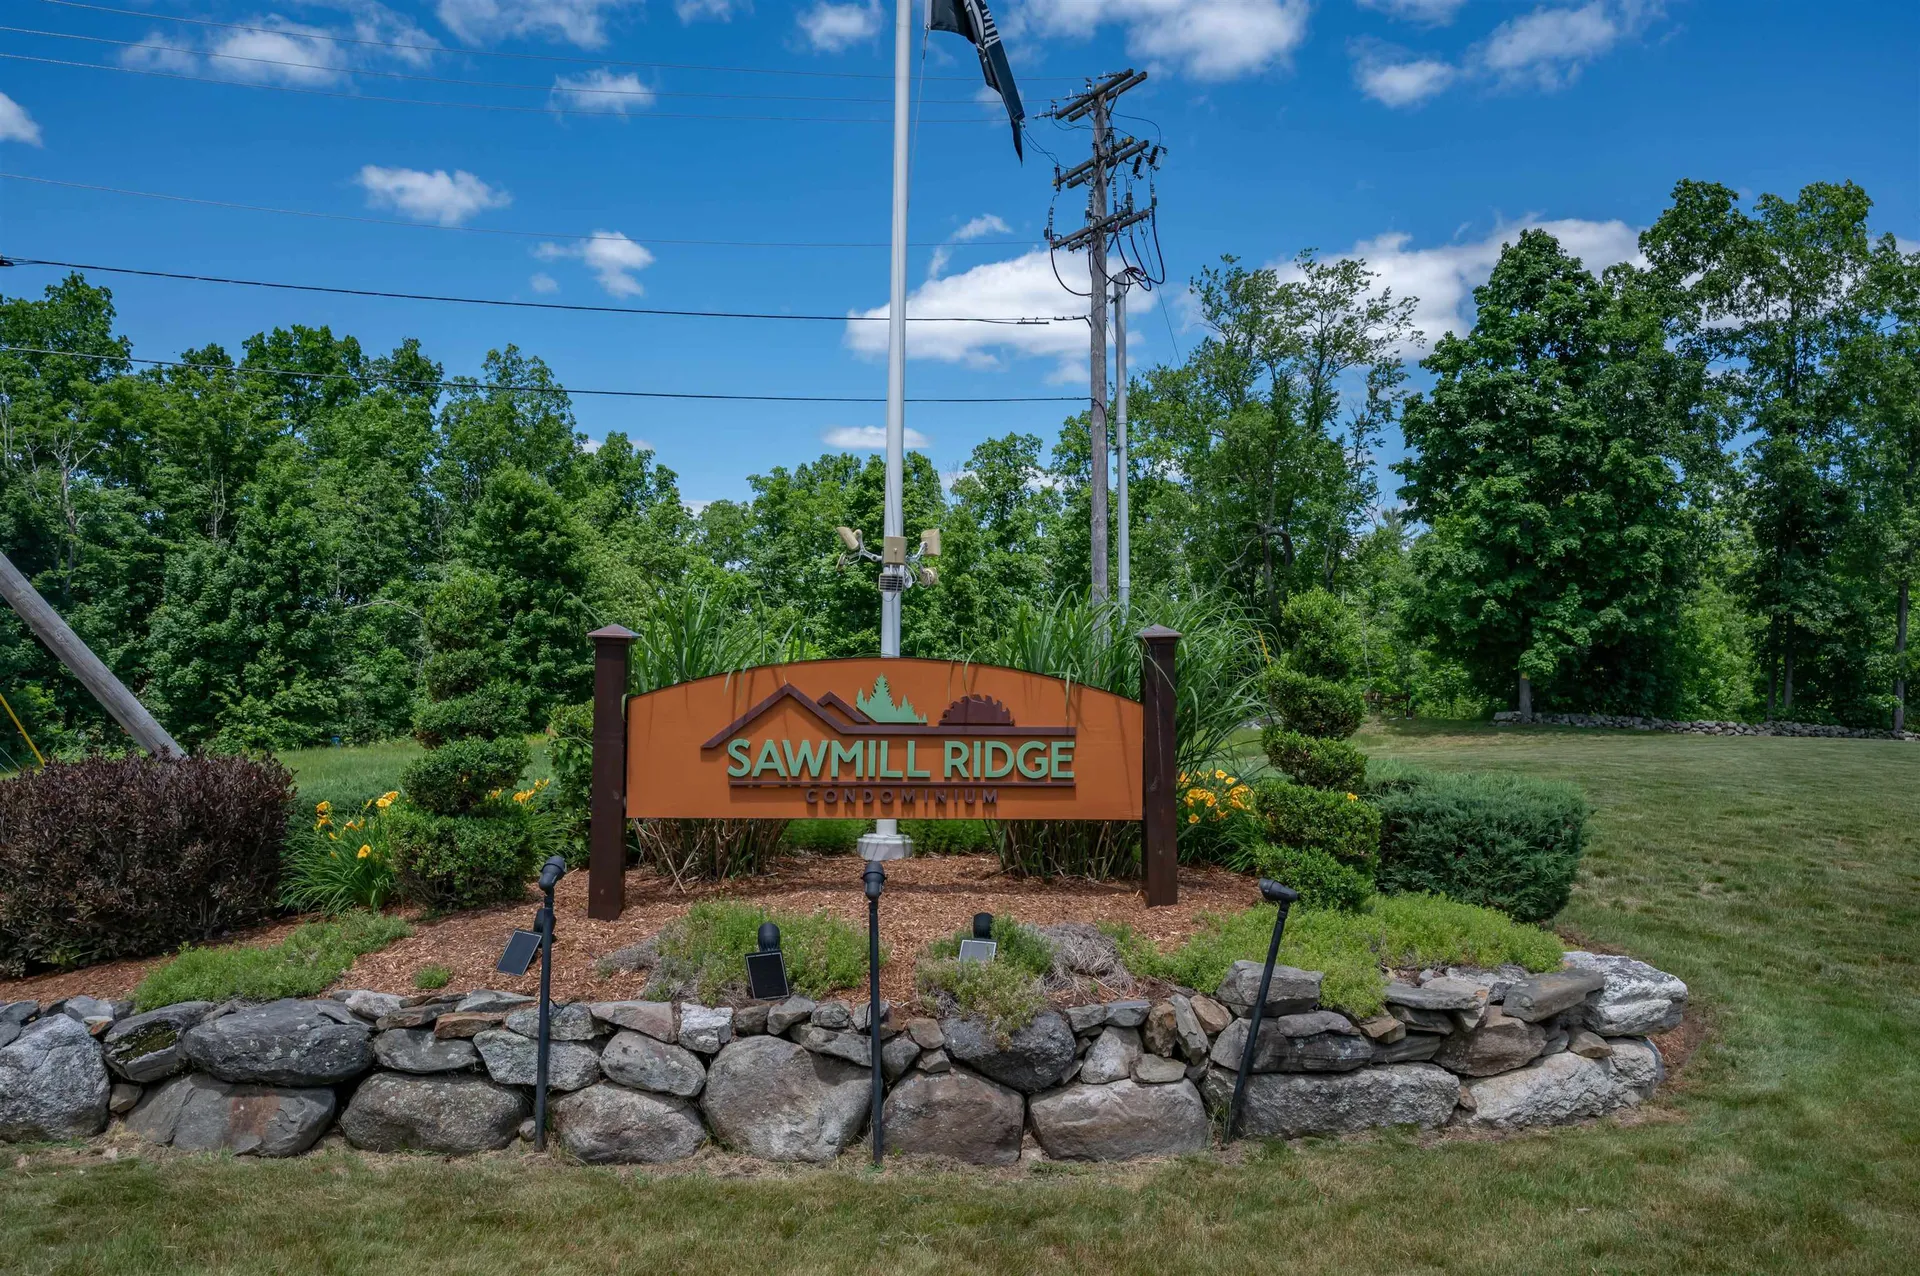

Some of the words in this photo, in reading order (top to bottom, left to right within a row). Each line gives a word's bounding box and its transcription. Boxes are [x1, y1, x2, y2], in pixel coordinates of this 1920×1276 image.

[727, 738, 931, 778] SAWMILL
[944, 740, 1075, 779] RIDGE
[805, 788, 998, 804] CONDOMINIUM
